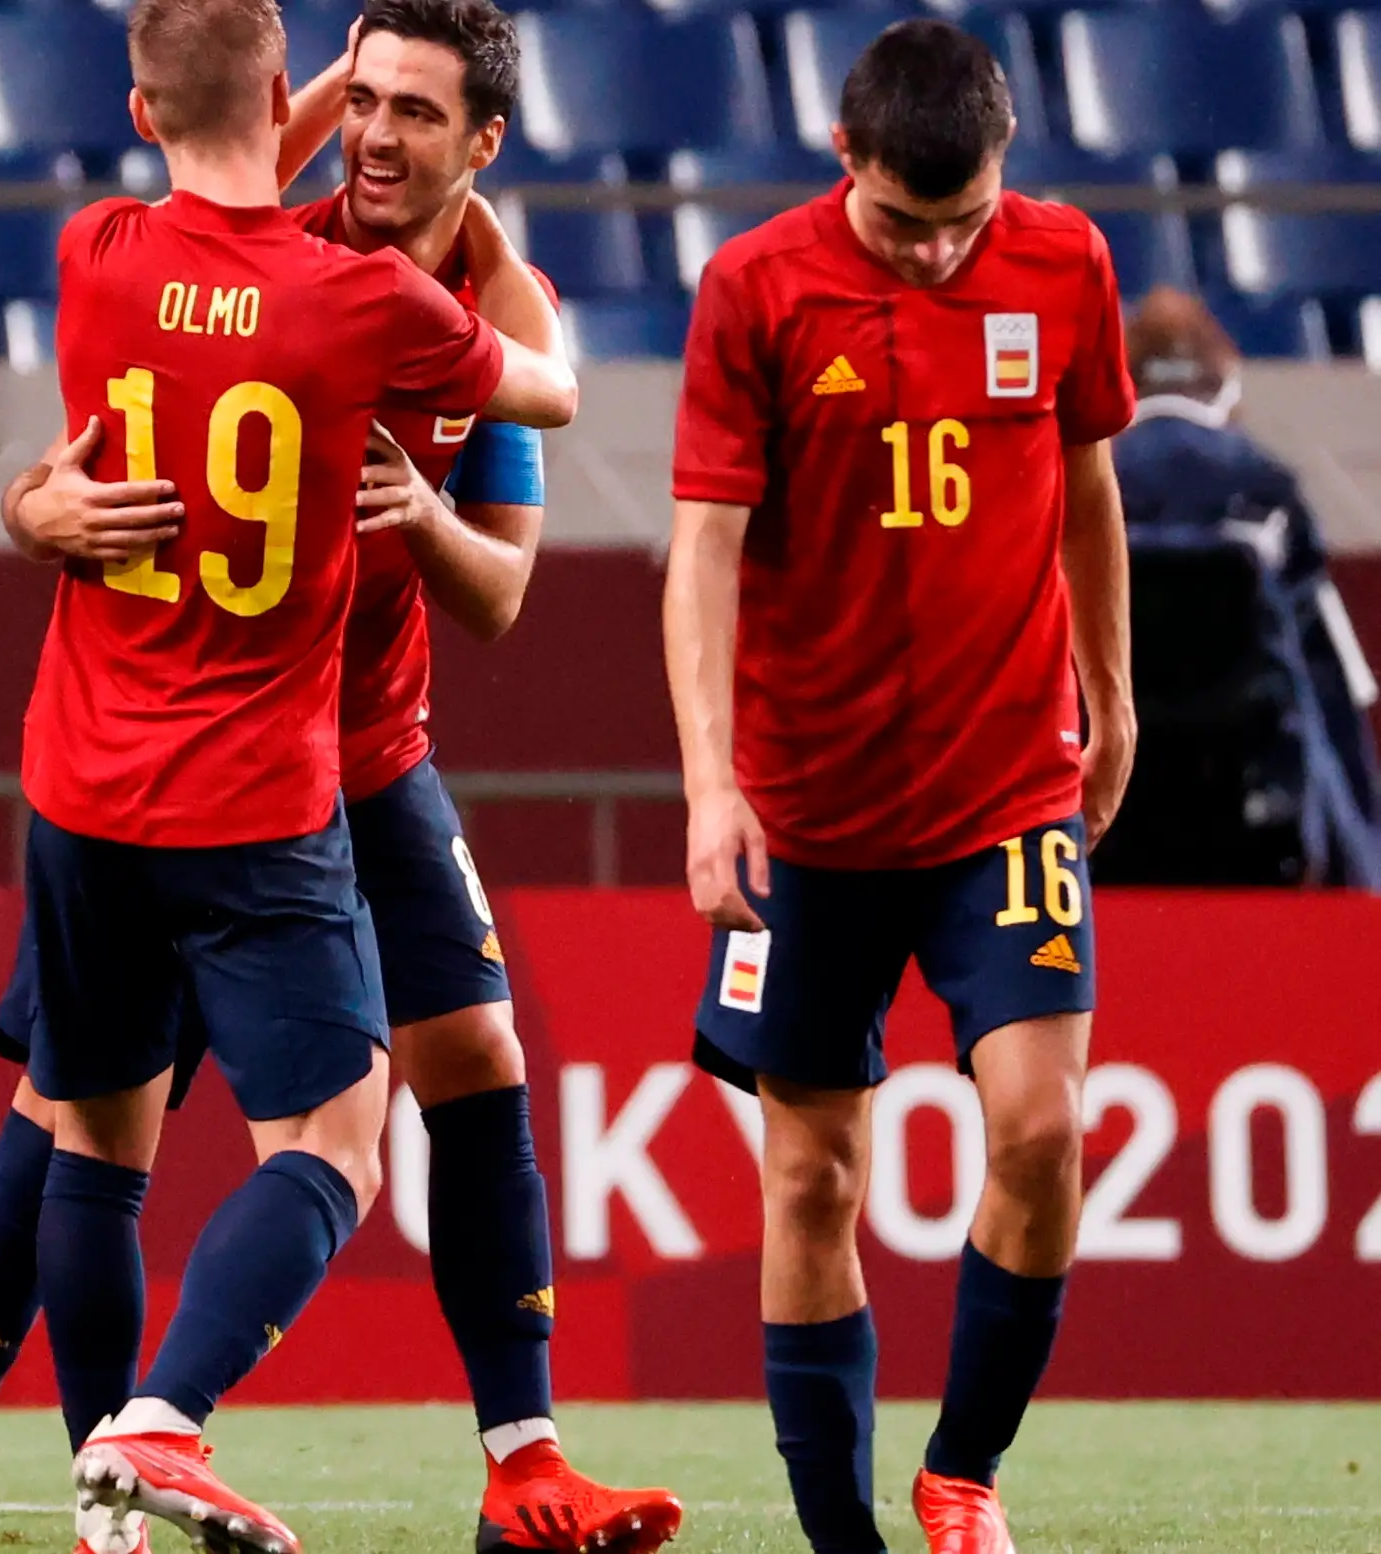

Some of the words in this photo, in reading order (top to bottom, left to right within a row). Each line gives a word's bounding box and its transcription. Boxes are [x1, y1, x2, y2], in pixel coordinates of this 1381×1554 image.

[158, 281, 261, 337] OLMO
[103, 367, 302, 617] 19
[880, 418, 971, 529] 16
[996, 829, 1083, 927] 16
[1075, 1062, 1381, 1262] 20
